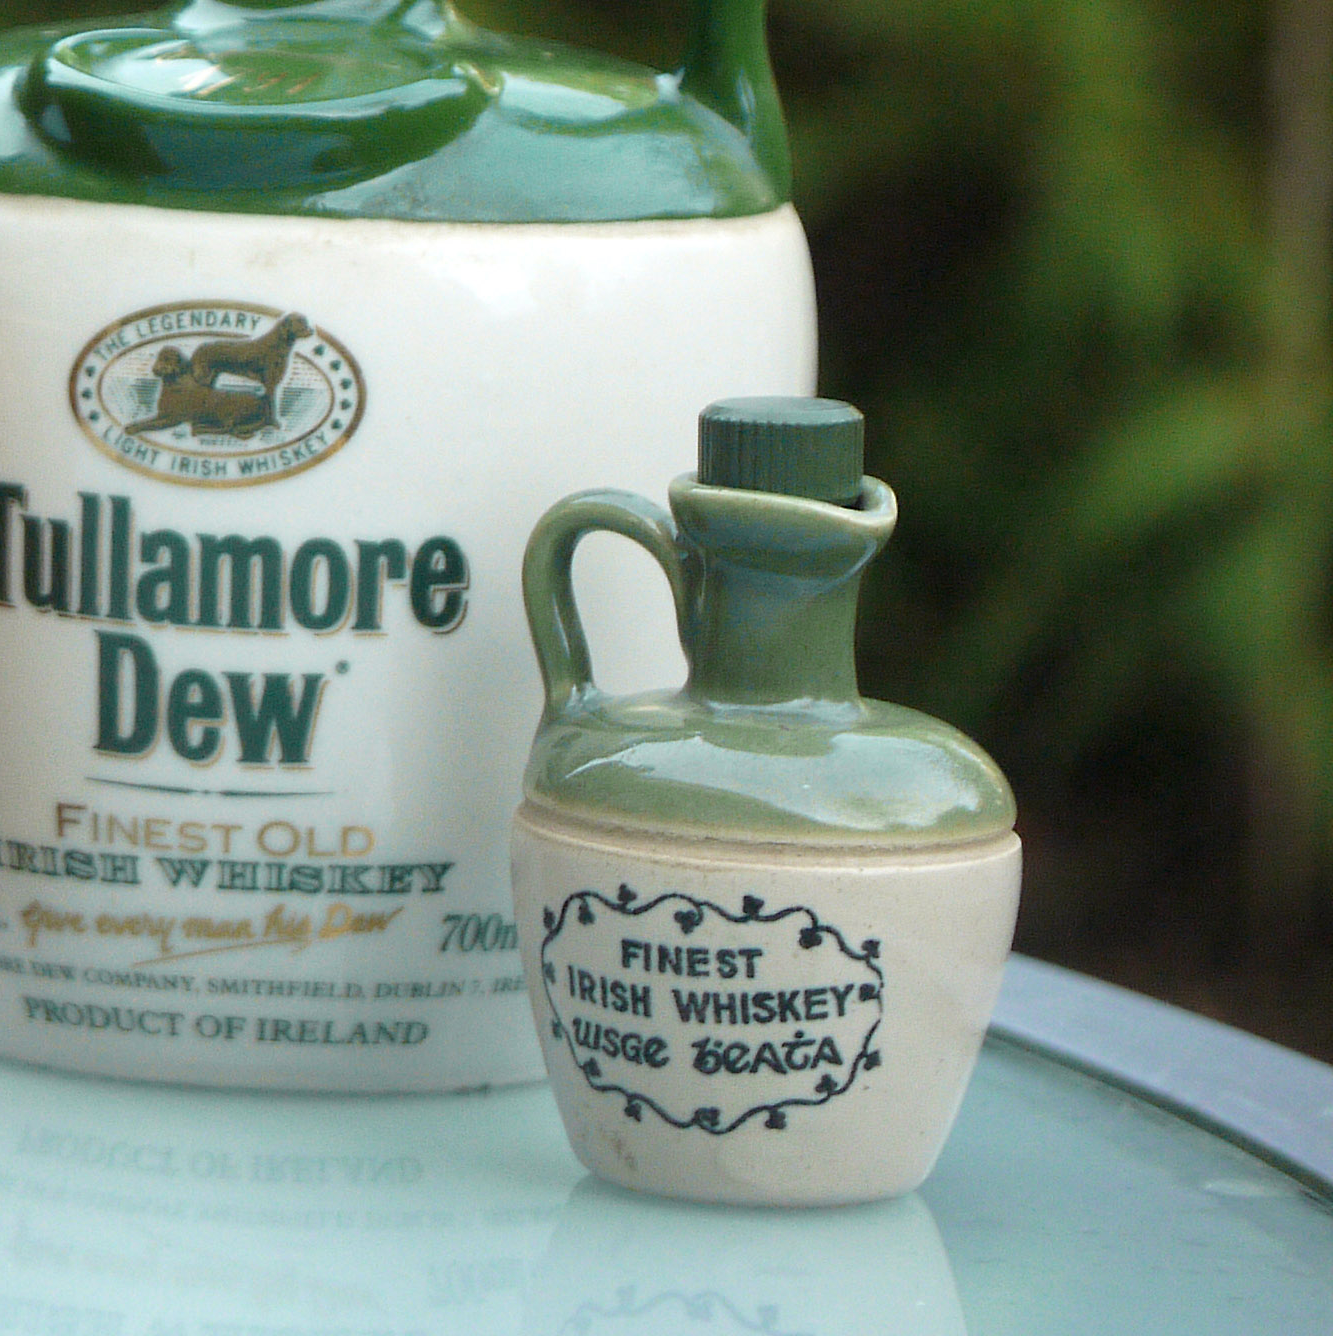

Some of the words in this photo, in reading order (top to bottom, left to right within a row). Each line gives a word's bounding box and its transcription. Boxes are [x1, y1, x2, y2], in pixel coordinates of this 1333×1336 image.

[93, 333, 131, 362] THE
[135, 312, 262, 339] LEGENDARY
[102, 425, 161, 464] LIGHT
[170, 456, 227, 476] IRISH
[237, 433, 329, 475] WHISKEY
[54, 802, 242, 859] FINEST
[255, 820, 376, 859] OLD
[156, 856, 456, 895] WHISKEY
[620, 938, 764, 980] FINEST
[567, 964, 653, 1018] IRISH
[671, 983, 856, 1025] WHISKEY
[22, 995, 183, 1038] PRODUCT
[194, 1013, 246, 1040] OF
[255, 1018, 430, 1045] IRELAND
